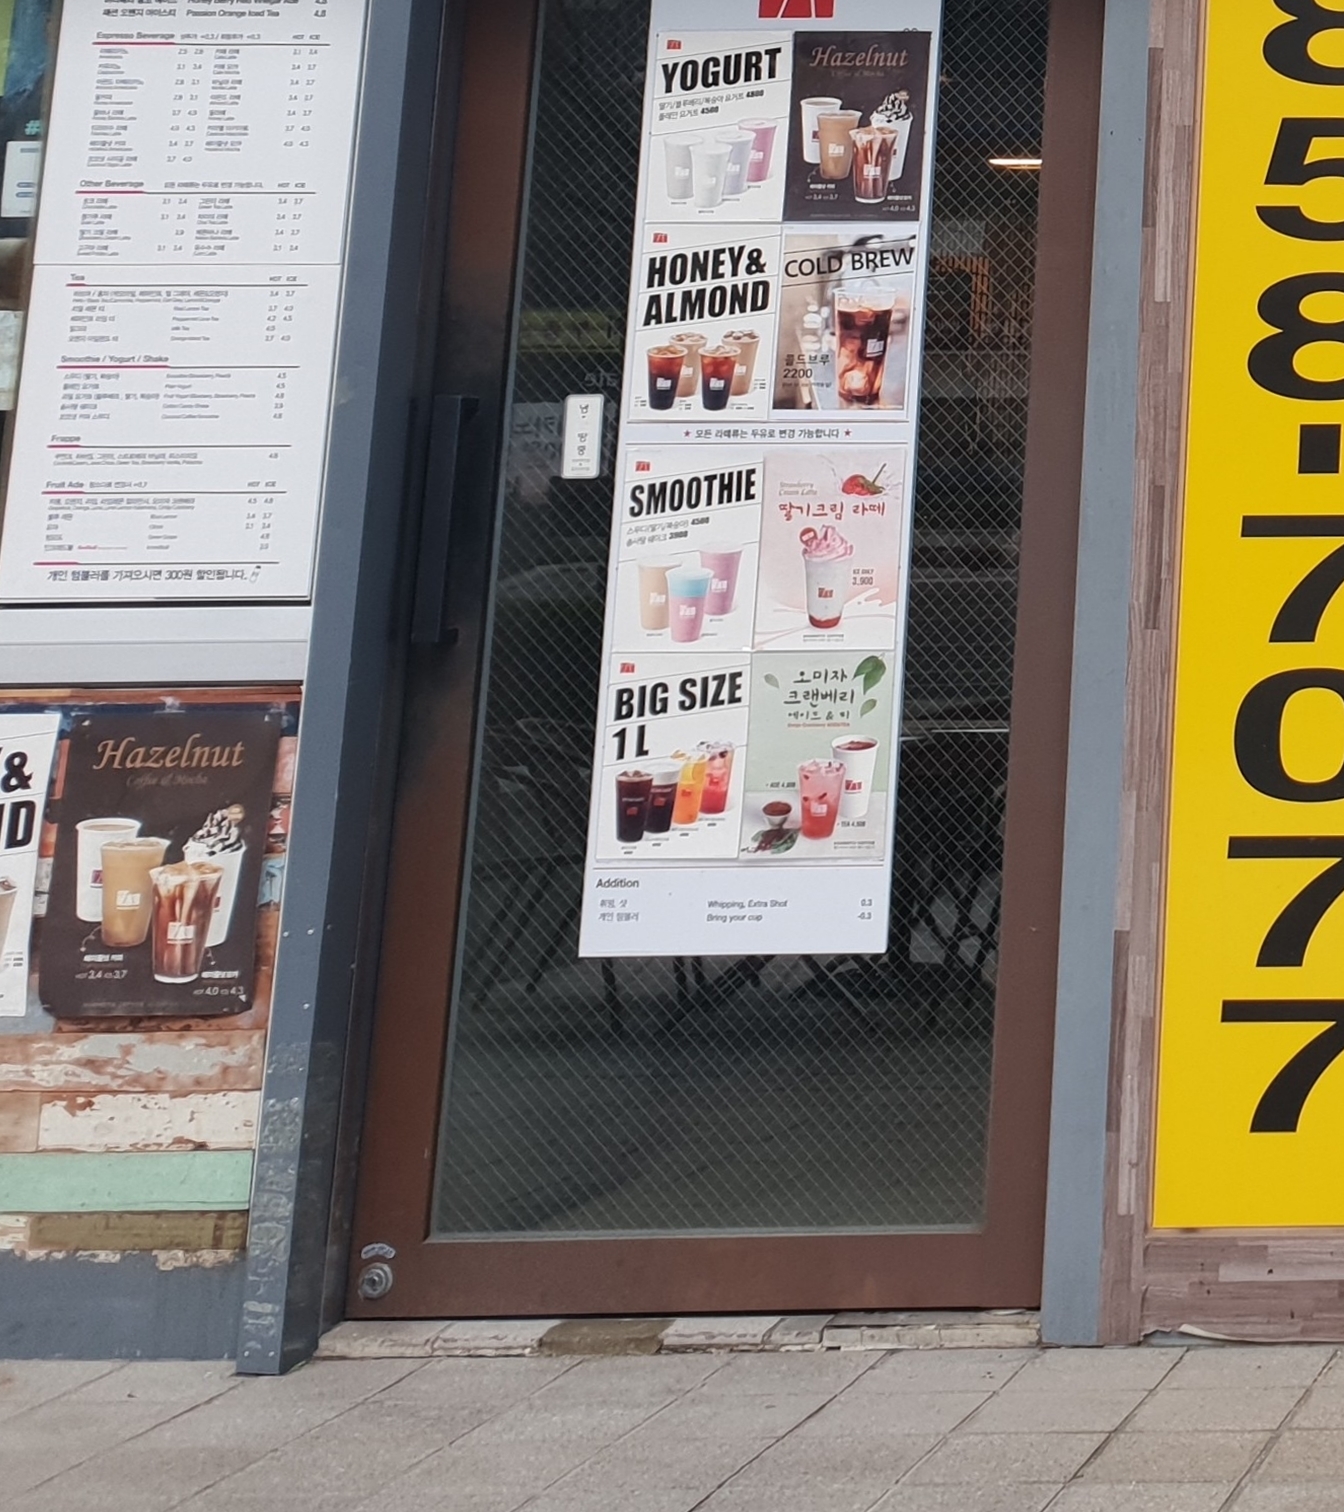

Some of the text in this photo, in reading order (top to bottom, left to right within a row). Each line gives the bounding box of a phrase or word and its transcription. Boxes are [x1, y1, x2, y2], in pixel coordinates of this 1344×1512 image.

[661, 47, 782, 94] YOGURT
[809, 44, 910, 68] Hazelnut
[647, 245, 767, 288] HONEY&
[785, 247, 914, 277] COLD BREW
[643, 280, 770, 326] ALMOND
[629, 468, 756, 518] SMOOTHIE
[778, 502, 844, 522] 딸기크림
[793, 668, 847, 684] 오미자
[613, 671, 743, 721] BIG SIZE
[783, 688, 855, 708] 크랜베리
[93, 734, 245, 769] Hazelnut
[596, 879, 639, 888] Addition
